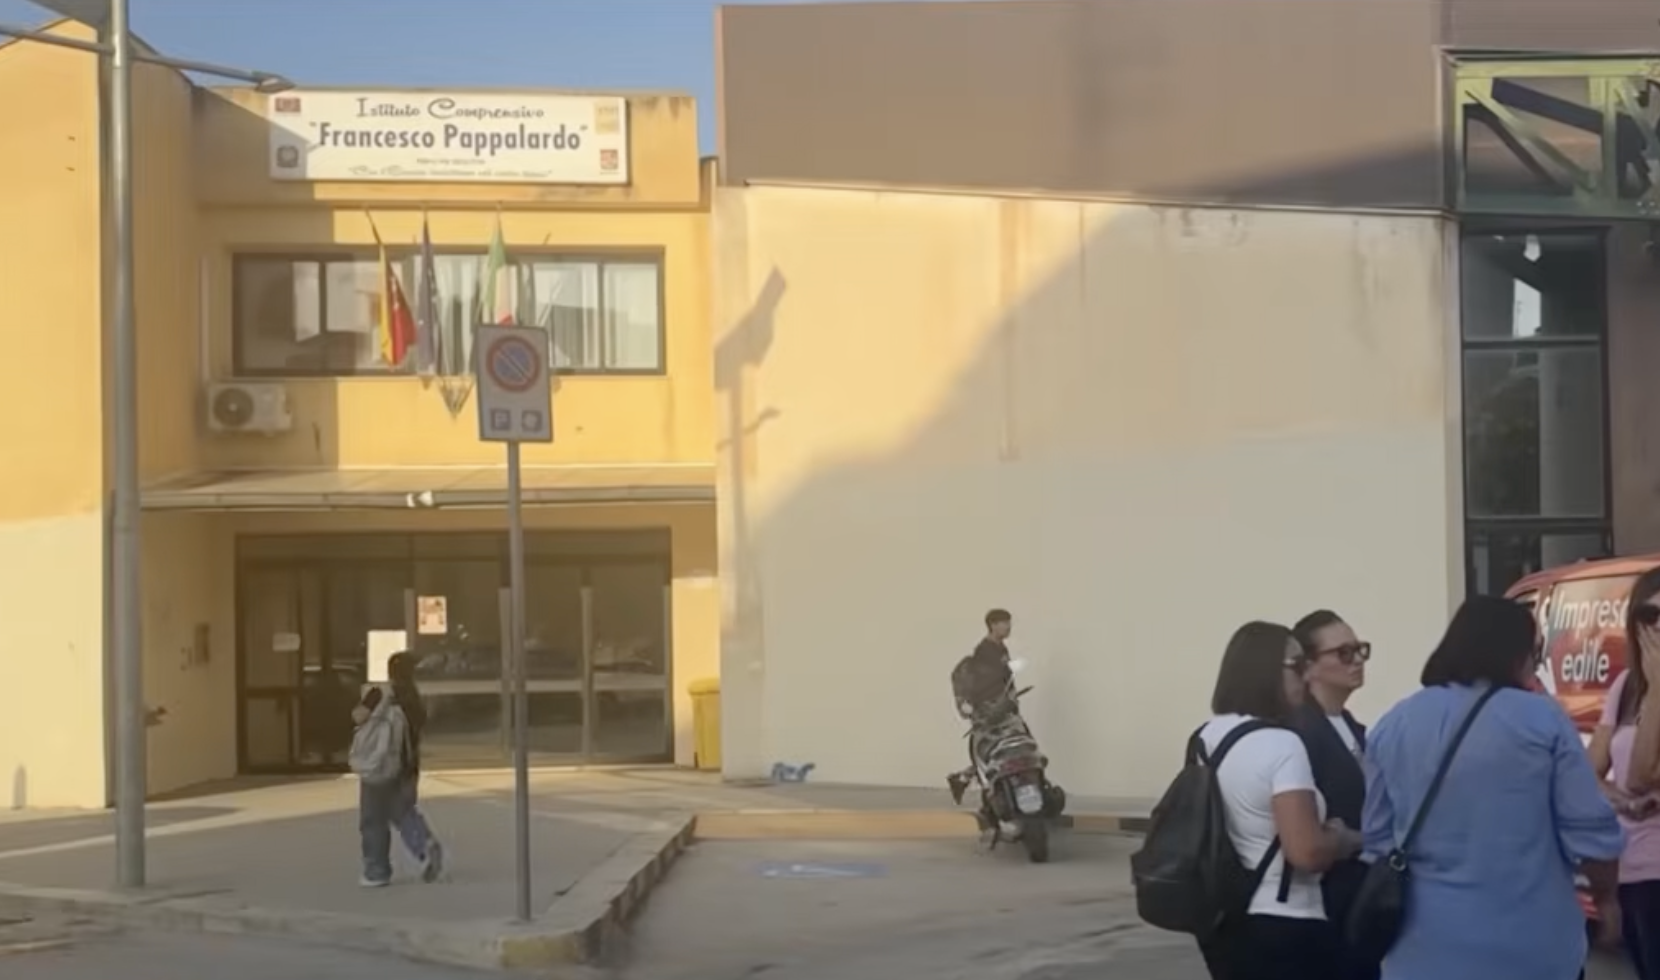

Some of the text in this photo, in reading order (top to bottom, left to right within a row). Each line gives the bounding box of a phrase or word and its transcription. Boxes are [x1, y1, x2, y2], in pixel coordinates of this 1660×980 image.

[356, 97, 544, 119] Istituto Comprensivo
[309, 122, 588, 156] "Francesco Pappalardo"
[1562, 637, 1610, 683] edile
